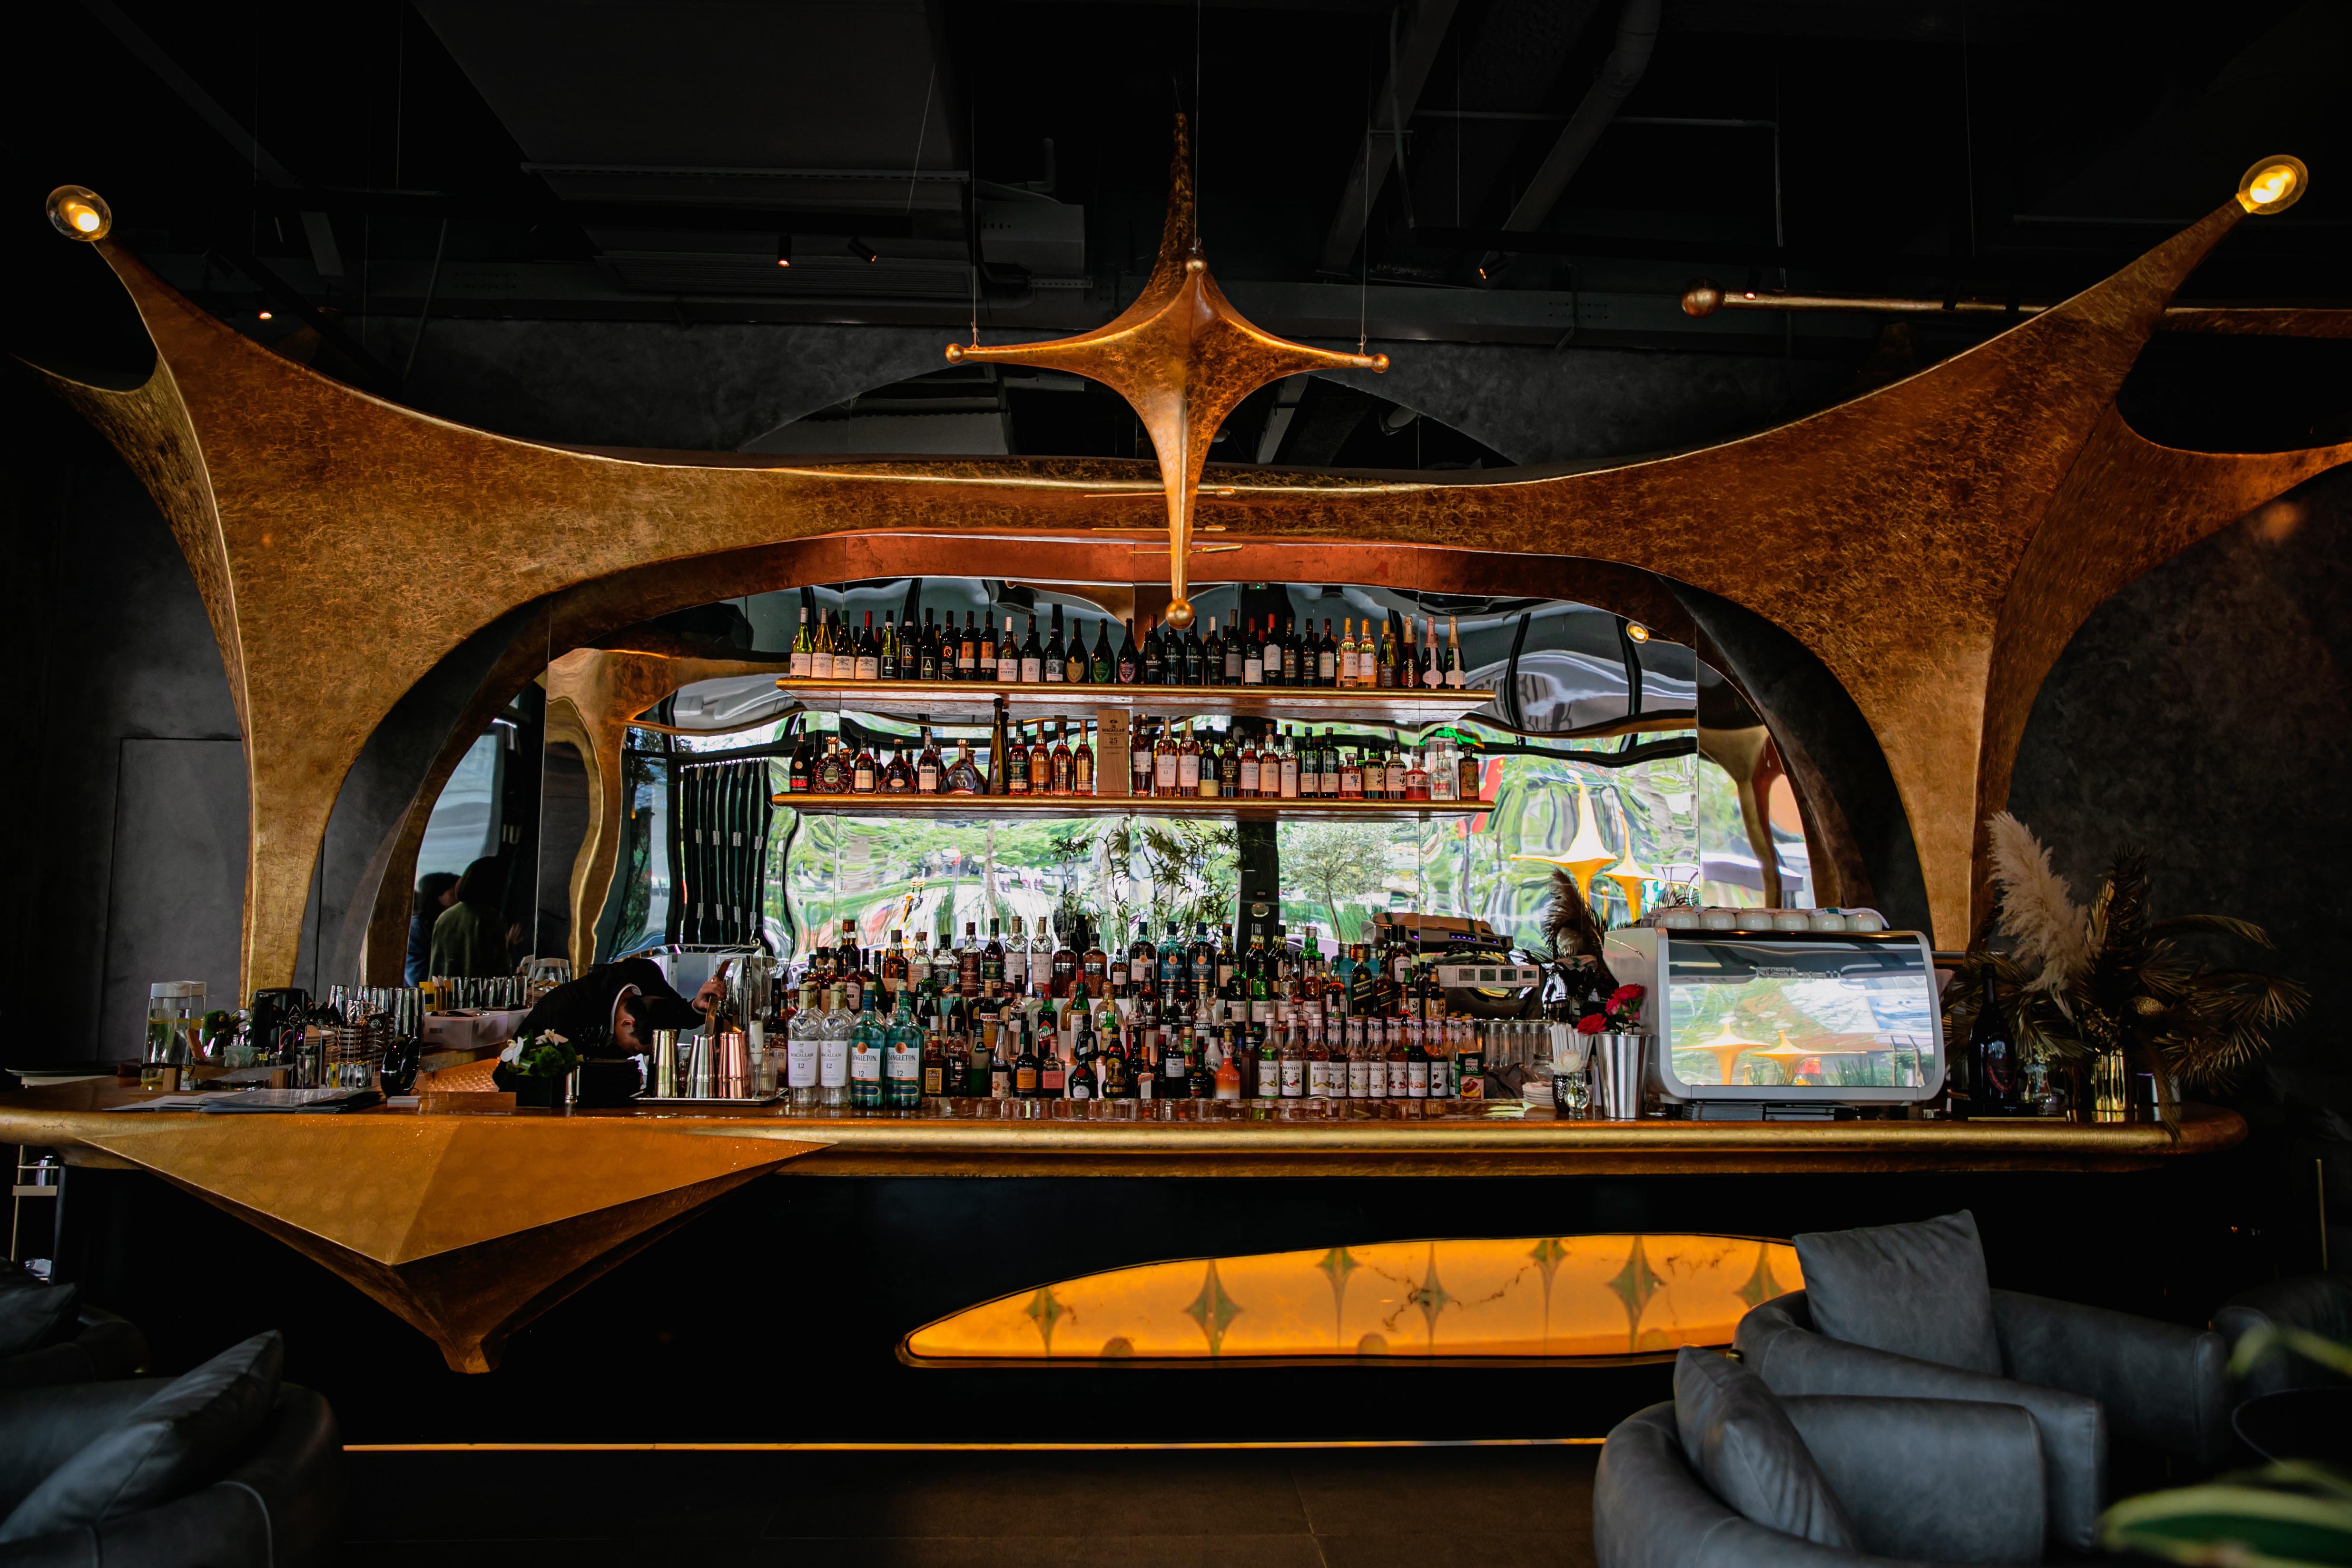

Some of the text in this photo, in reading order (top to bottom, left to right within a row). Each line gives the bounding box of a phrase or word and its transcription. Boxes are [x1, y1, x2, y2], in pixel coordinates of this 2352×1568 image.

[905, 648, 912, 656] R
[887, 658, 893, 667] P
[925, 660, 932, 668] A
[1038, 1027, 1055, 1042] CYNAR
[852, 1053, 877, 1061] SINGLETON
[888, 1053, 916, 1061] SINGLETON
